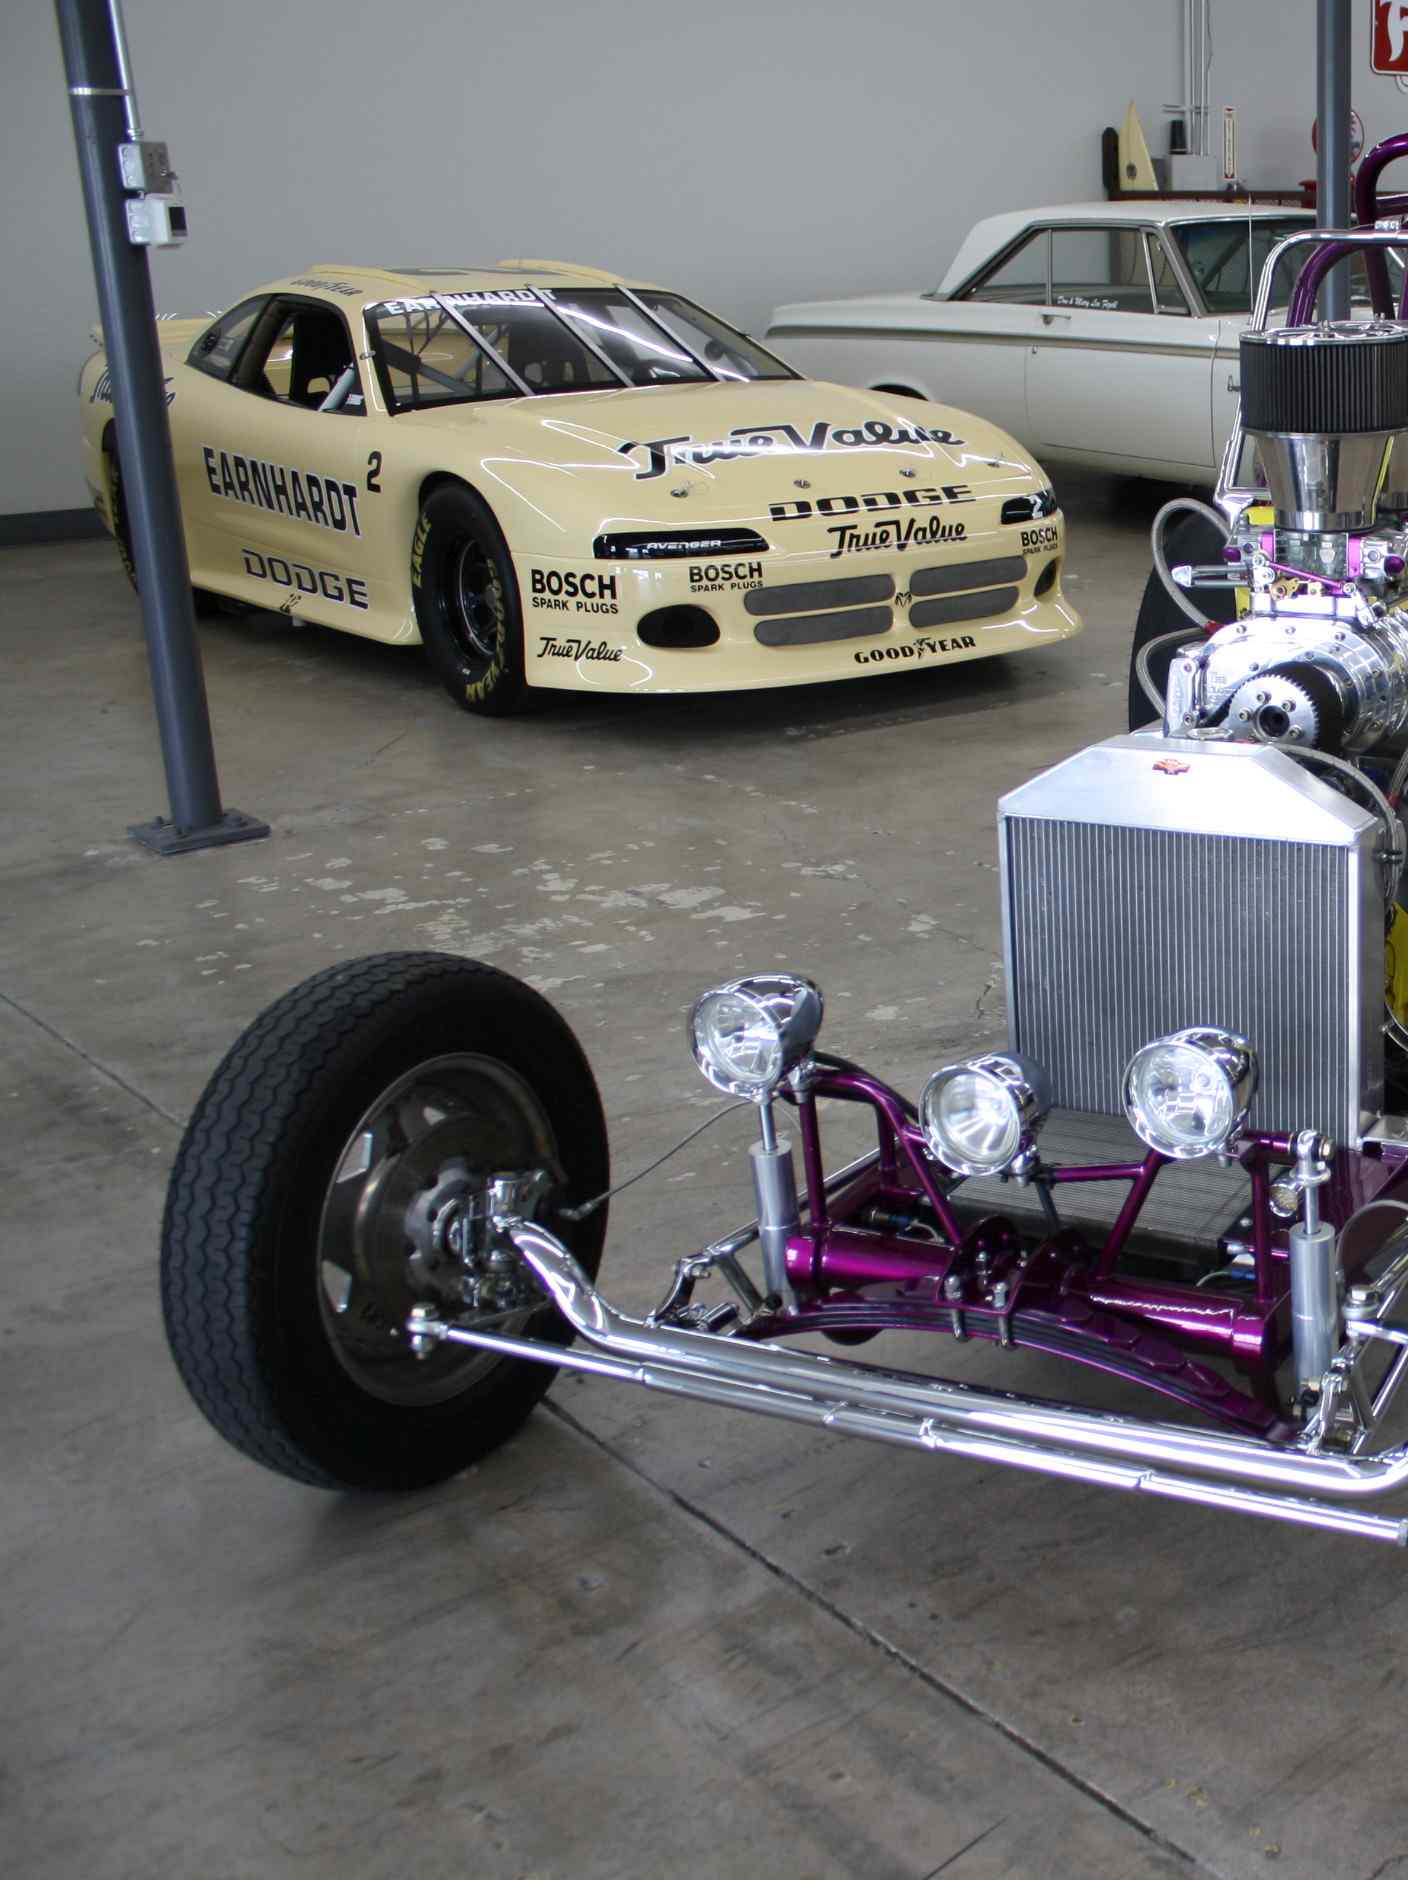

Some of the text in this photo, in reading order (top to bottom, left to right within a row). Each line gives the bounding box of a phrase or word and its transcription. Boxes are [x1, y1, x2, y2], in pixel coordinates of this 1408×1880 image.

[367, 450, 382, 493] 2
[203, 446, 360, 536] EARNHARDT
[768, 484, 976, 521] DODGE
[1029, 494, 1043, 519] 2
[647, 539, 721, 549] AVENGER
[827, 515, 967, 558] True Value
[1020, 526, 1058, 547] BOSCH
[242, 549, 369, 609] DODGE
[531, 569, 617, 600] BOSCH
[689, 561, 763, 583] BOSCH
[690, 580, 764, 593] SPARK PLUGS
[532, 597, 619, 615] SPARK PLUGS
[537, 637, 623, 662] True Value
